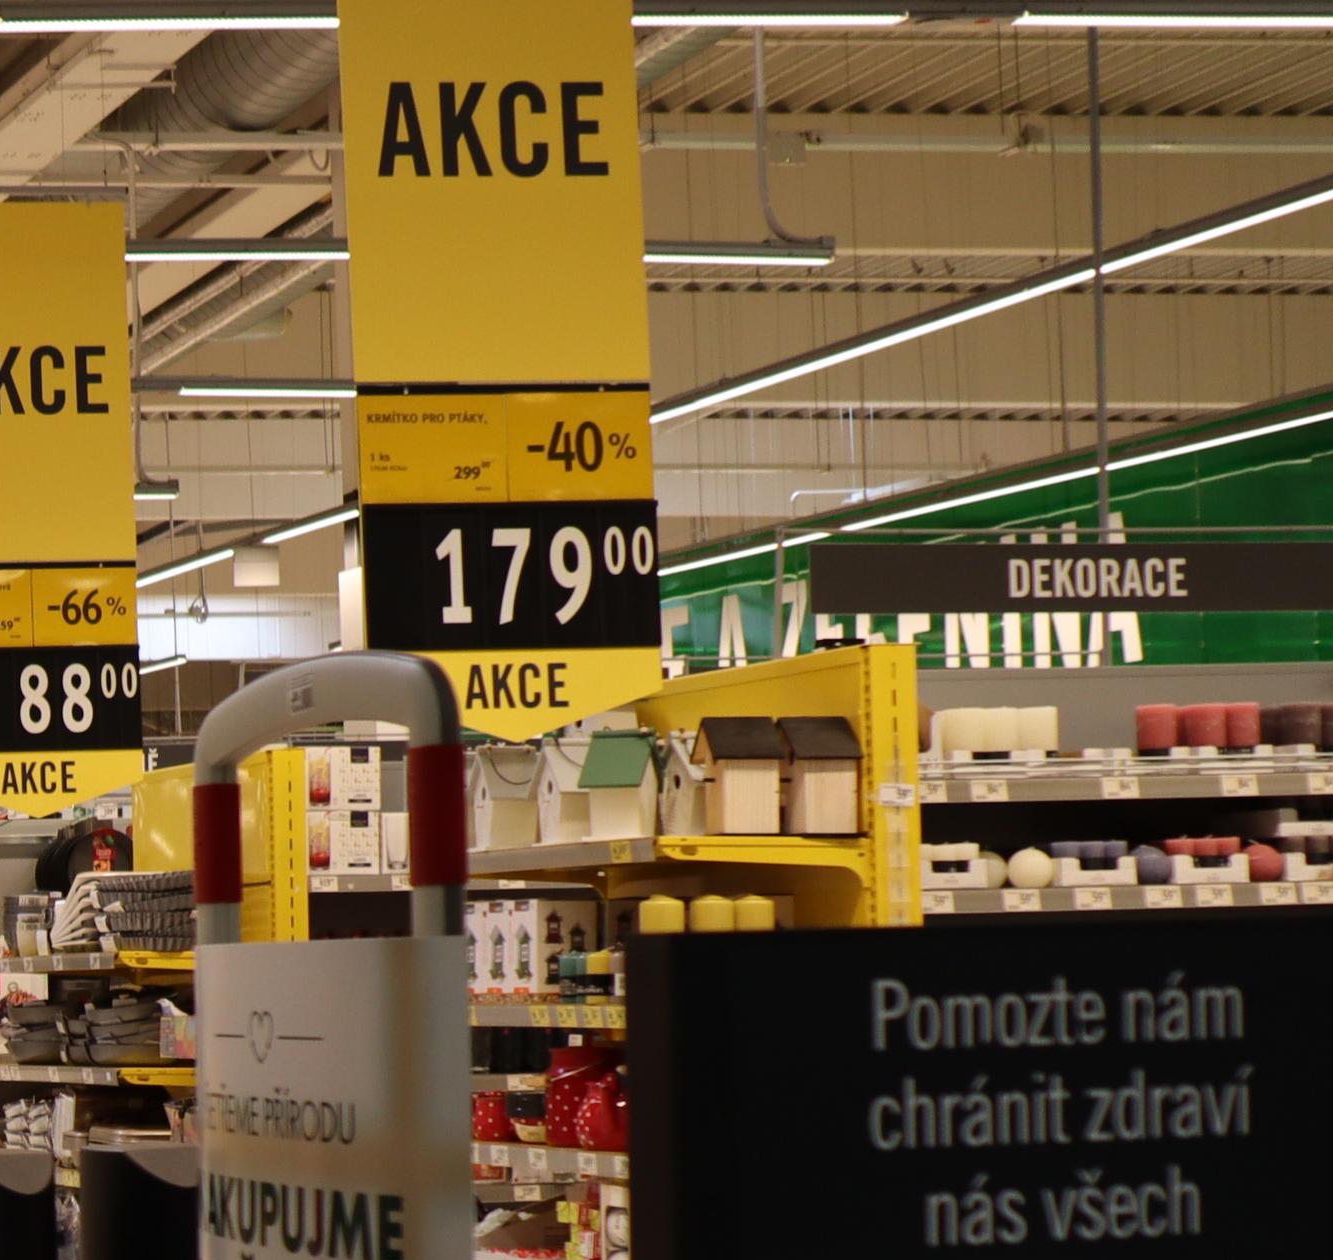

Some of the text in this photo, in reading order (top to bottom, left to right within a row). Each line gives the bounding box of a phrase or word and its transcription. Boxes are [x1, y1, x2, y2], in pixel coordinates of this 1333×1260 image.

[377, 82, 609, 178] AKCE
[422, 414, 445, 424] PRO
[1008, 557, 1187, 599] DEKORACE
[464, 661, 571, 710] AKCE
[1, 760, 77, 795] AKCE
[871, 971, 1246, 1051] Pomozte nám
[264, 1086, 356, 1144] PŘÍRODU
[869, 1064, 1254, 1151] chránit zdraví
[924, 1162, 1201, 1247] nás všech
